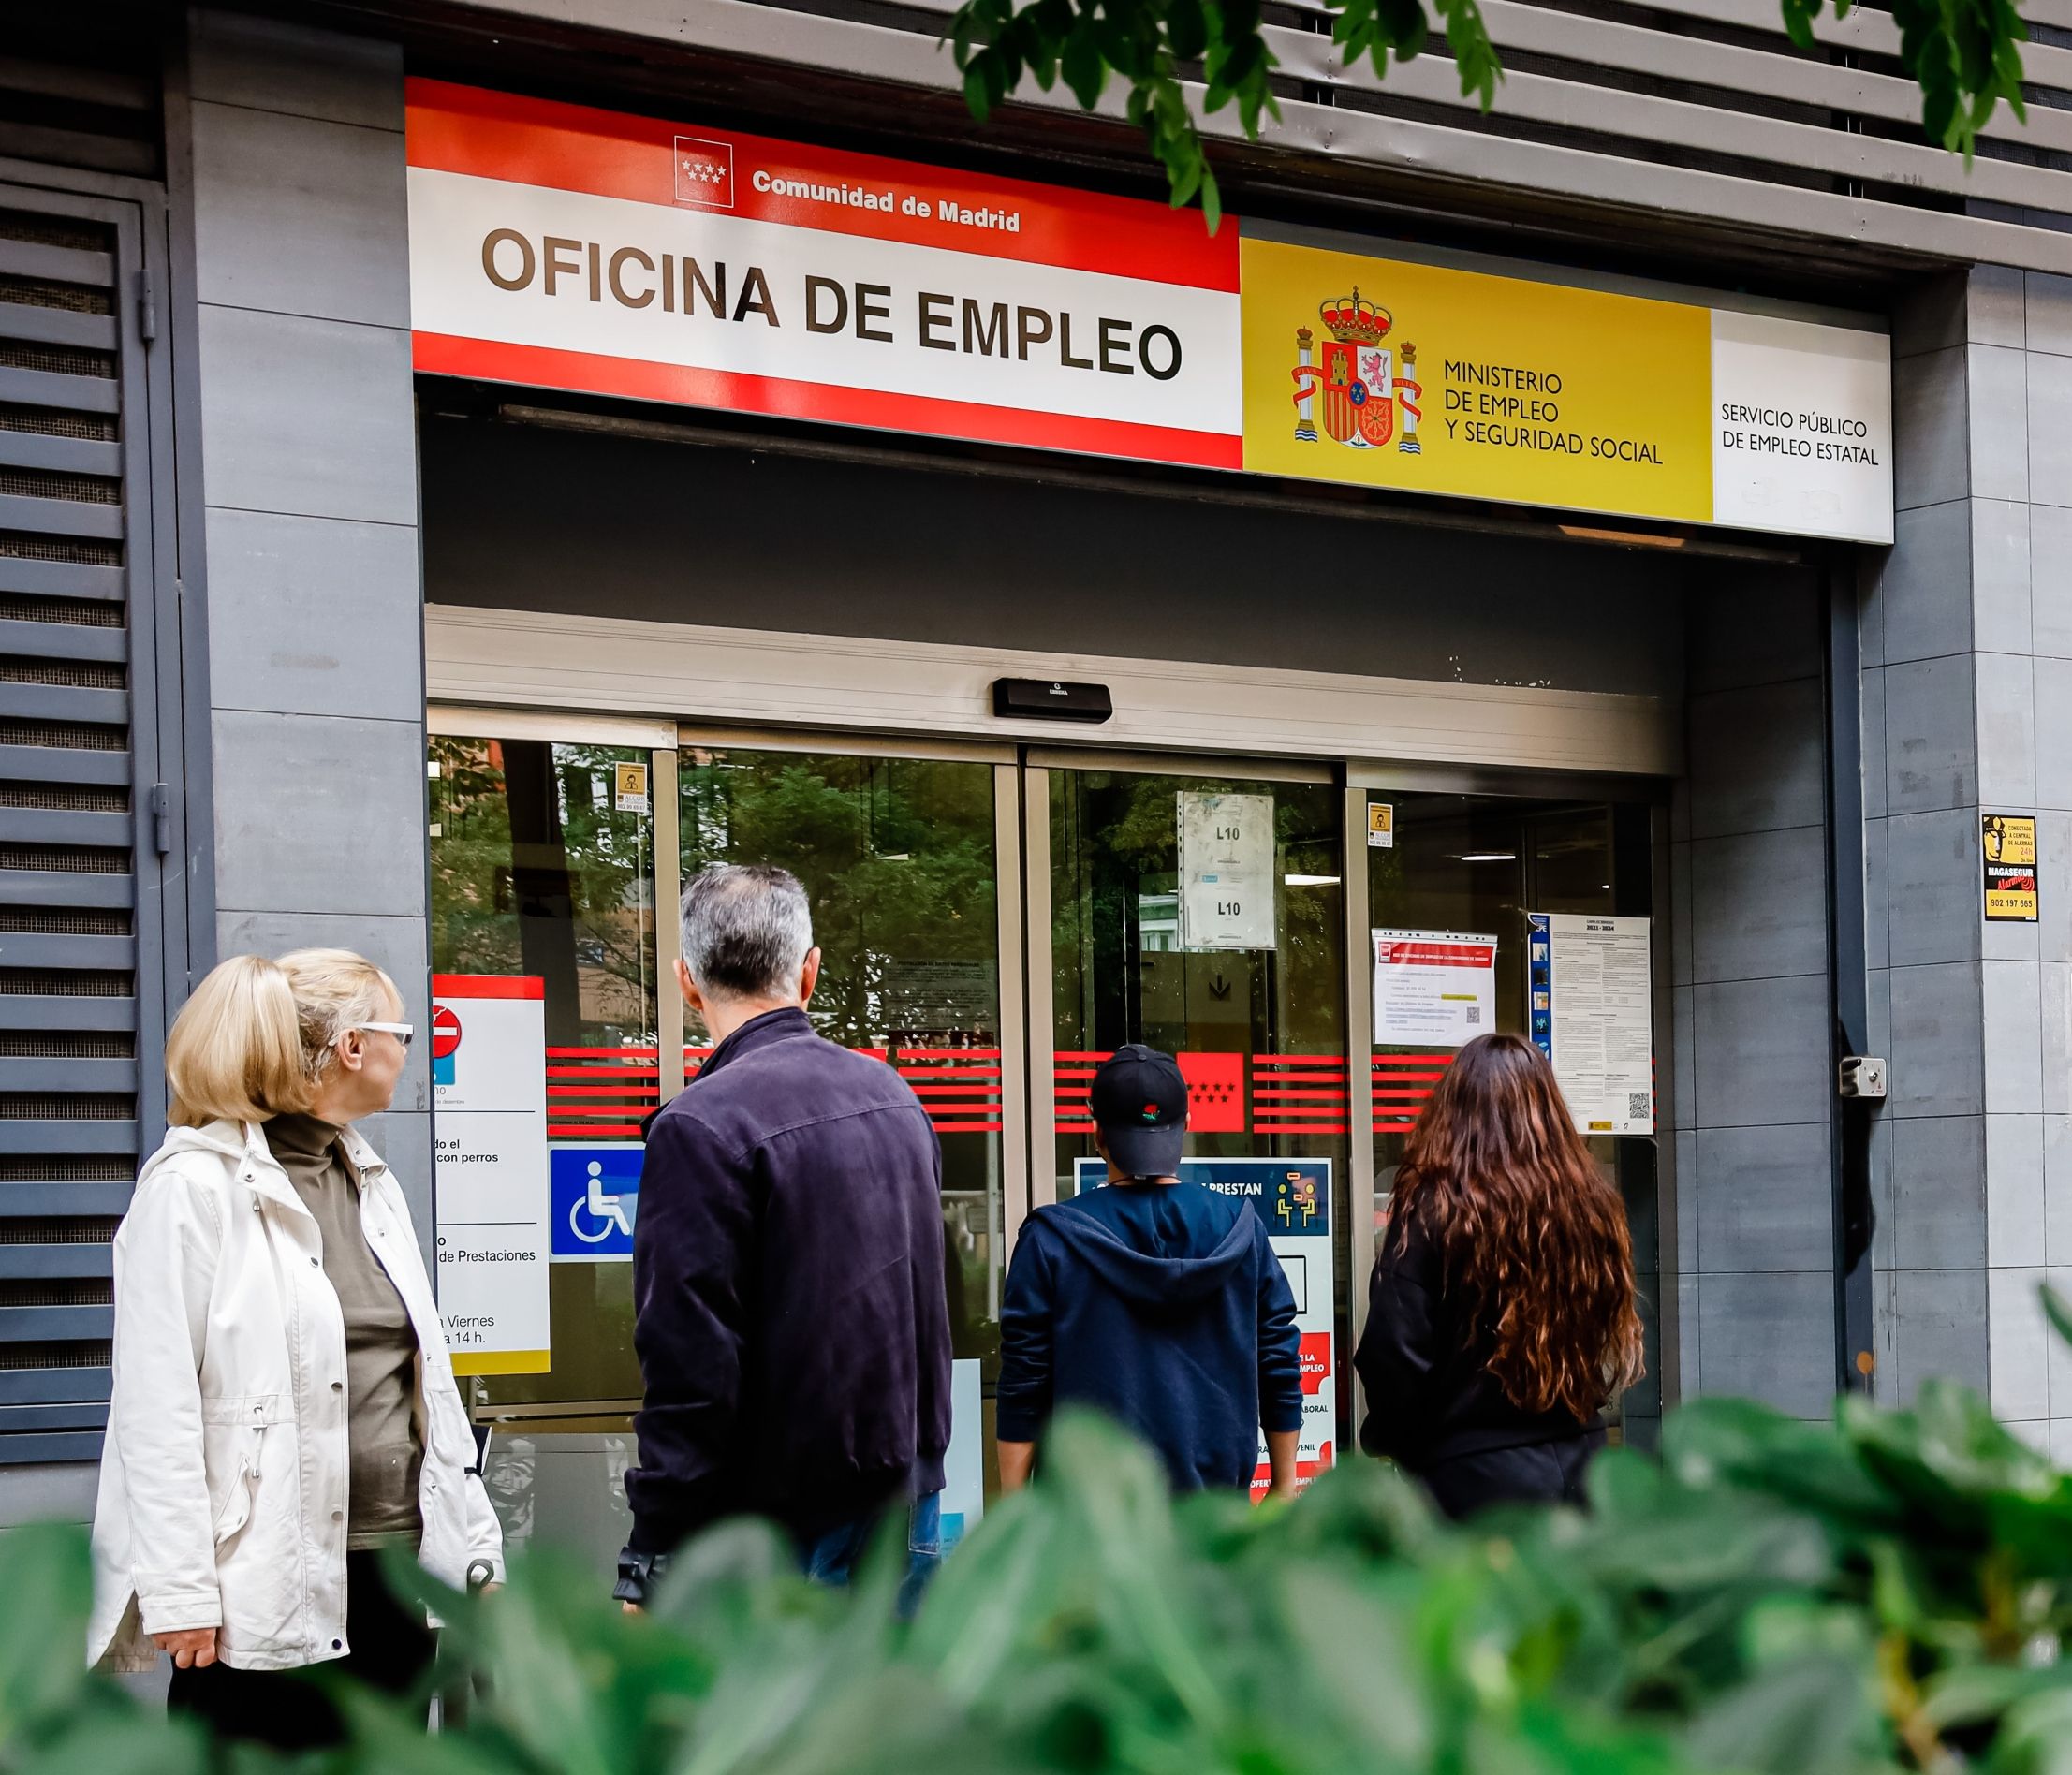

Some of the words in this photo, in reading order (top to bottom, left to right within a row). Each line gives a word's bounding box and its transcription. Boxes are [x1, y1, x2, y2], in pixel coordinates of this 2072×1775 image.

[752, 170, 894, 213] Comunidad
[902, 196, 931, 218] de
[939, 200, 1021, 233] Madrid
[481, 227, 780, 328] OFICINA
[805, 274, 893, 343] DE
[918, 291, 1183, 381] EMPLEO
[1445, 359, 1562, 394] MINISTERIO
[1446, 389, 1472, 412] DE
[1480, 393, 1559, 422] EMPLEO
[1722, 403, 1793, 429] SERVICIO
[1800, 410, 1867, 438] PÚBLICO
[1445, 418, 1457, 440] Y
[1465, 421, 1583, 454] SEGURIDAD
[1591, 437, 1663, 465] SOCIAL
[1723, 431, 1743, 449] DE
[1750, 434, 1812, 458] EMPLEO
[1817, 443, 1879, 466] ESTATAL
[1216, 827, 1240, 841] L10
[2021, 847, 2032, 856] 24h
[1988, 867, 2034, 877] MAGASEGUR
[1218, 902, 1241, 916] L10
[2006, 899, 2018, 907] 197
[449, 1139, 460, 1149] el
[462, 1154, 499, 1164] perros
[1209, 1182, 1262, 1196] PRESTAN
[437, 1237, 447, 1246] o
[438, 1251, 454, 1262] de
[458, 1249, 536, 1262] Prestaciones
[447, 1315, 494, 1328] Viernes
[455, 1331, 470, 1343] 14
[474, 1331, 486, 1343] h.
[1299, 1364, 1324, 1372] MPLEO
